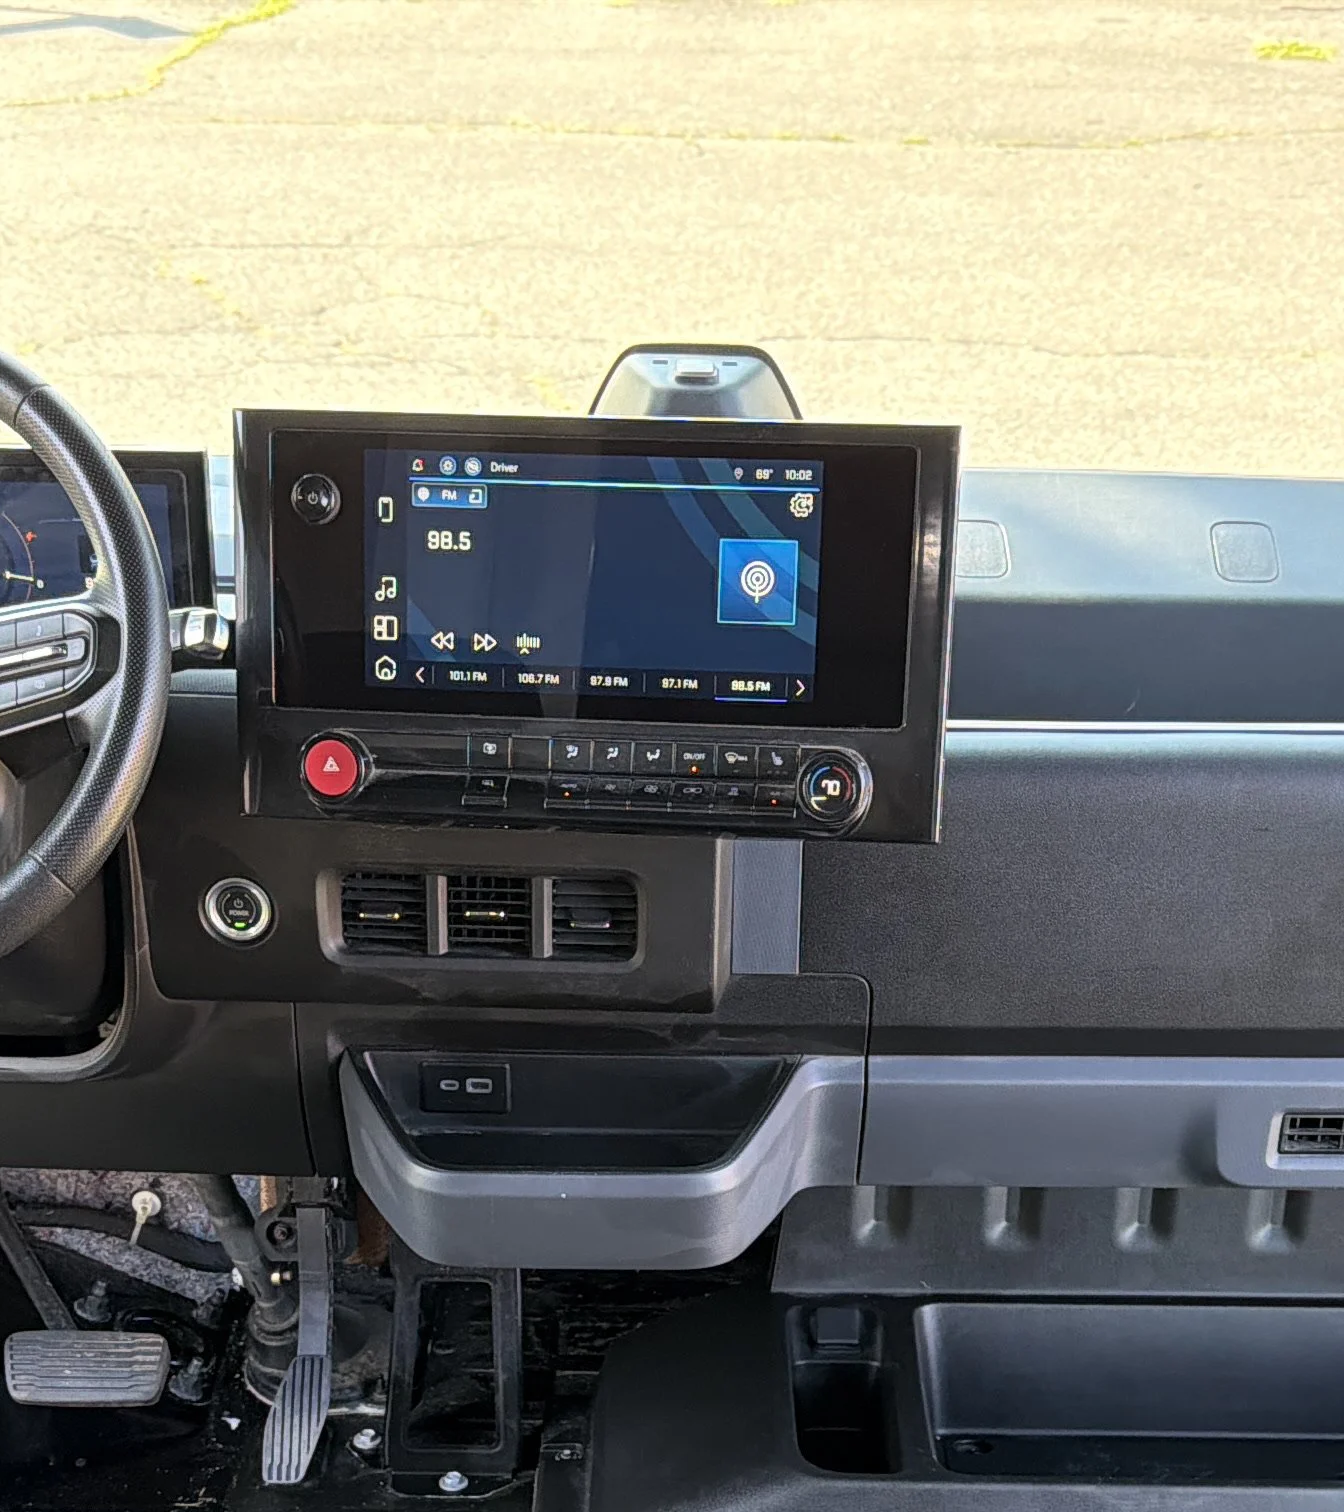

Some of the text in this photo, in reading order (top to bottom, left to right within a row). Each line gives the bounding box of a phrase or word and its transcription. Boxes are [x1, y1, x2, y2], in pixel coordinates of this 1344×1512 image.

[490, 461, 518, 474] Driver
[785, 469, 812, 480] 10:02
[441, 489, 457, 501] FM
[427, 530, 471, 551] 98.5
[449, 670, 488, 682] 101.1 FM
[544, 674, 560, 685] FM
[613, 676, 629, 687] FM
[661, 677, 699, 690] 97.1 FM
[731, 679, 771, 692] 98.5 FM
[683, 752, 706, 761] ON/OFF
[821, 779, 840, 796] 70
